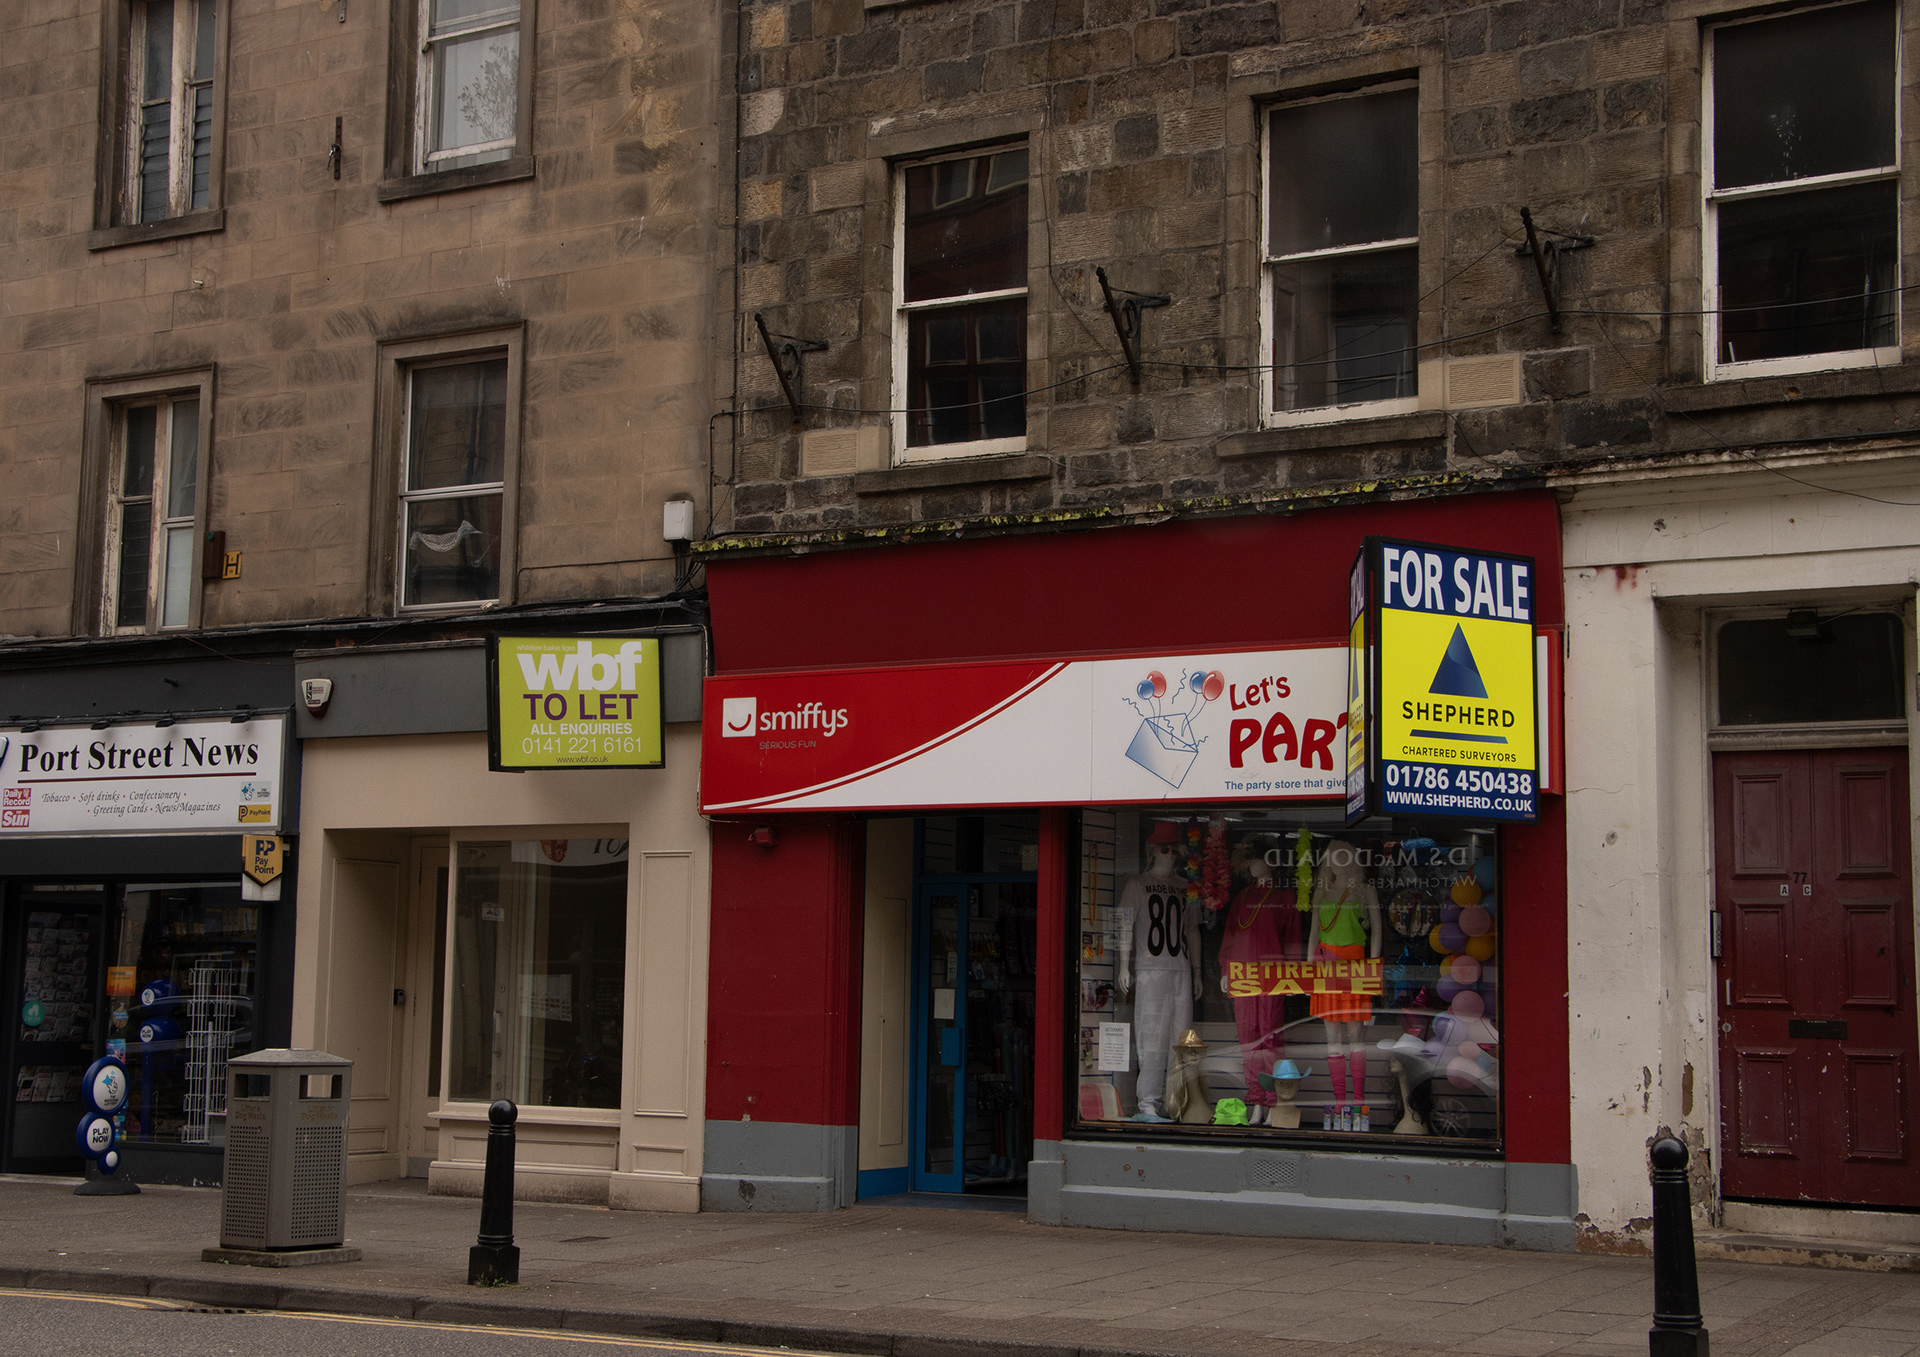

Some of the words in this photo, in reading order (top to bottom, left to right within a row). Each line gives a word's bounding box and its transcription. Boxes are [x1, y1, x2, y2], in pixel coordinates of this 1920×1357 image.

[1383, 547, 1445, 611] FOR
[1453, 556, 1529, 620] SALE
[517, 641, 642, 691] wbf
[1229, 676, 1291, 711] Let's
[523, 693, 567, 720] TO
[579, 694, 638, 720] LET
[1402, 700, 1516, 728] SHEPHERD
[760, 702, 848, 737] smiffys
[531, 723, 556, 735] ALL
[560, 723, 632, 735] ENQUIRIES
[522, 738, 561, 754] 0141
[568, 738, 596, 753] 221
[603, 737, 641, 753] 6161
[759, 741, 796, 749] SERIOUS
[798, 740, 816, 748] FUN
[1229, 712, 1348, 771] PAR
[19, 744, 80, 773] Port
[88, 741, 173, 770] Street
[182, 737, 259, 767] News
[556, 755, 608, 763] www.wbf.co.uk
[1402, 745, 1457, 759] CHARTERED
[1460, 750, 1516, 763] SURVEYORS
[1224, 781, 1243, 790] The
[1246, 780, 1272, 791] party
[1275, 779, 1301, 789] store
[1304, 779, 1323, 788] that
[1386, 764, 1449, 788] 01786
[1456, 769, 1532, 795] 450438
[4, 789, 23, 799] Daily
[4, 798, 30, 806] Record
[42, 792, 70, 802] Tobacco
[78, 791, 95, 805] Soft
[97, 790, 120, 802] drinks
[129, 789, 181, 803] Confectionery
[1386, 791, 1532, 812] WWW.SHEPHERD.CO.UK
[93, 804, 125, 817] Greeting
[127, 802, 148, 813] Cards
[155, 801, 221, 815] News/Magazines
[2, 811, 29, 826] Sun
[254, 865, 274, 874] Point
[255, 857, 268, 867] Pay
[1793, 872, 1807, 883] 77
[1145, 885, 1167, 894] MADE
[1168, 886, 1175, 894] IN
[1782, 886, 1787, 894] A
[1804, 886, 1810, 894] C
[1229, 958, 1380, 980] RETIREMENT
[1229, 978, 1382, 997] SALE
[92, 1127, 109, 1136] PLAY
[92, 1135, 109, 1143] NOW
